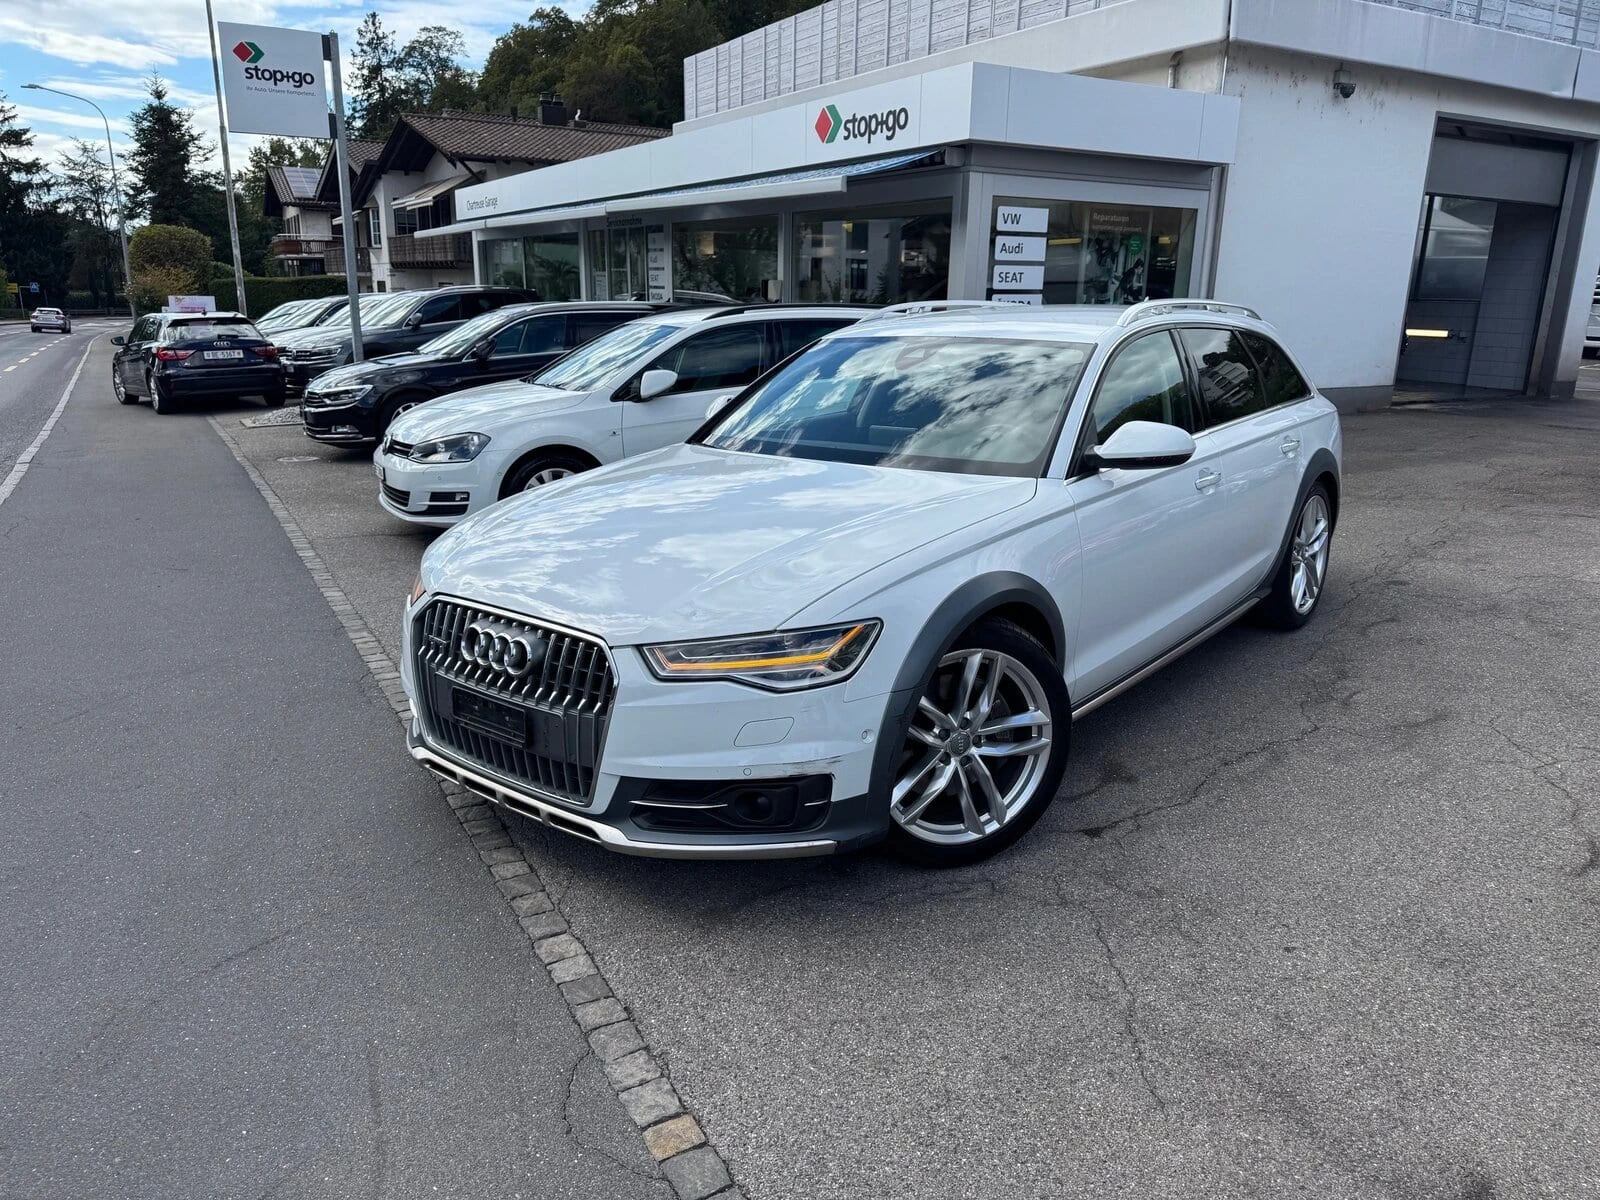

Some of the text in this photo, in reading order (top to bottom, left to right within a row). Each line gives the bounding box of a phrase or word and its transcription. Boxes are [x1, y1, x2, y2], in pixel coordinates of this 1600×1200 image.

[244, 65, 315, 88] stop+go
[843, 107, 909, 144] stop+go
[1002, 213, 1021, 225] VW
[1093, 213, 1129, 222] Reparaturen
[999, 242, 1024, 254] Audi
[998, 272, 1024, 283] SEAT
